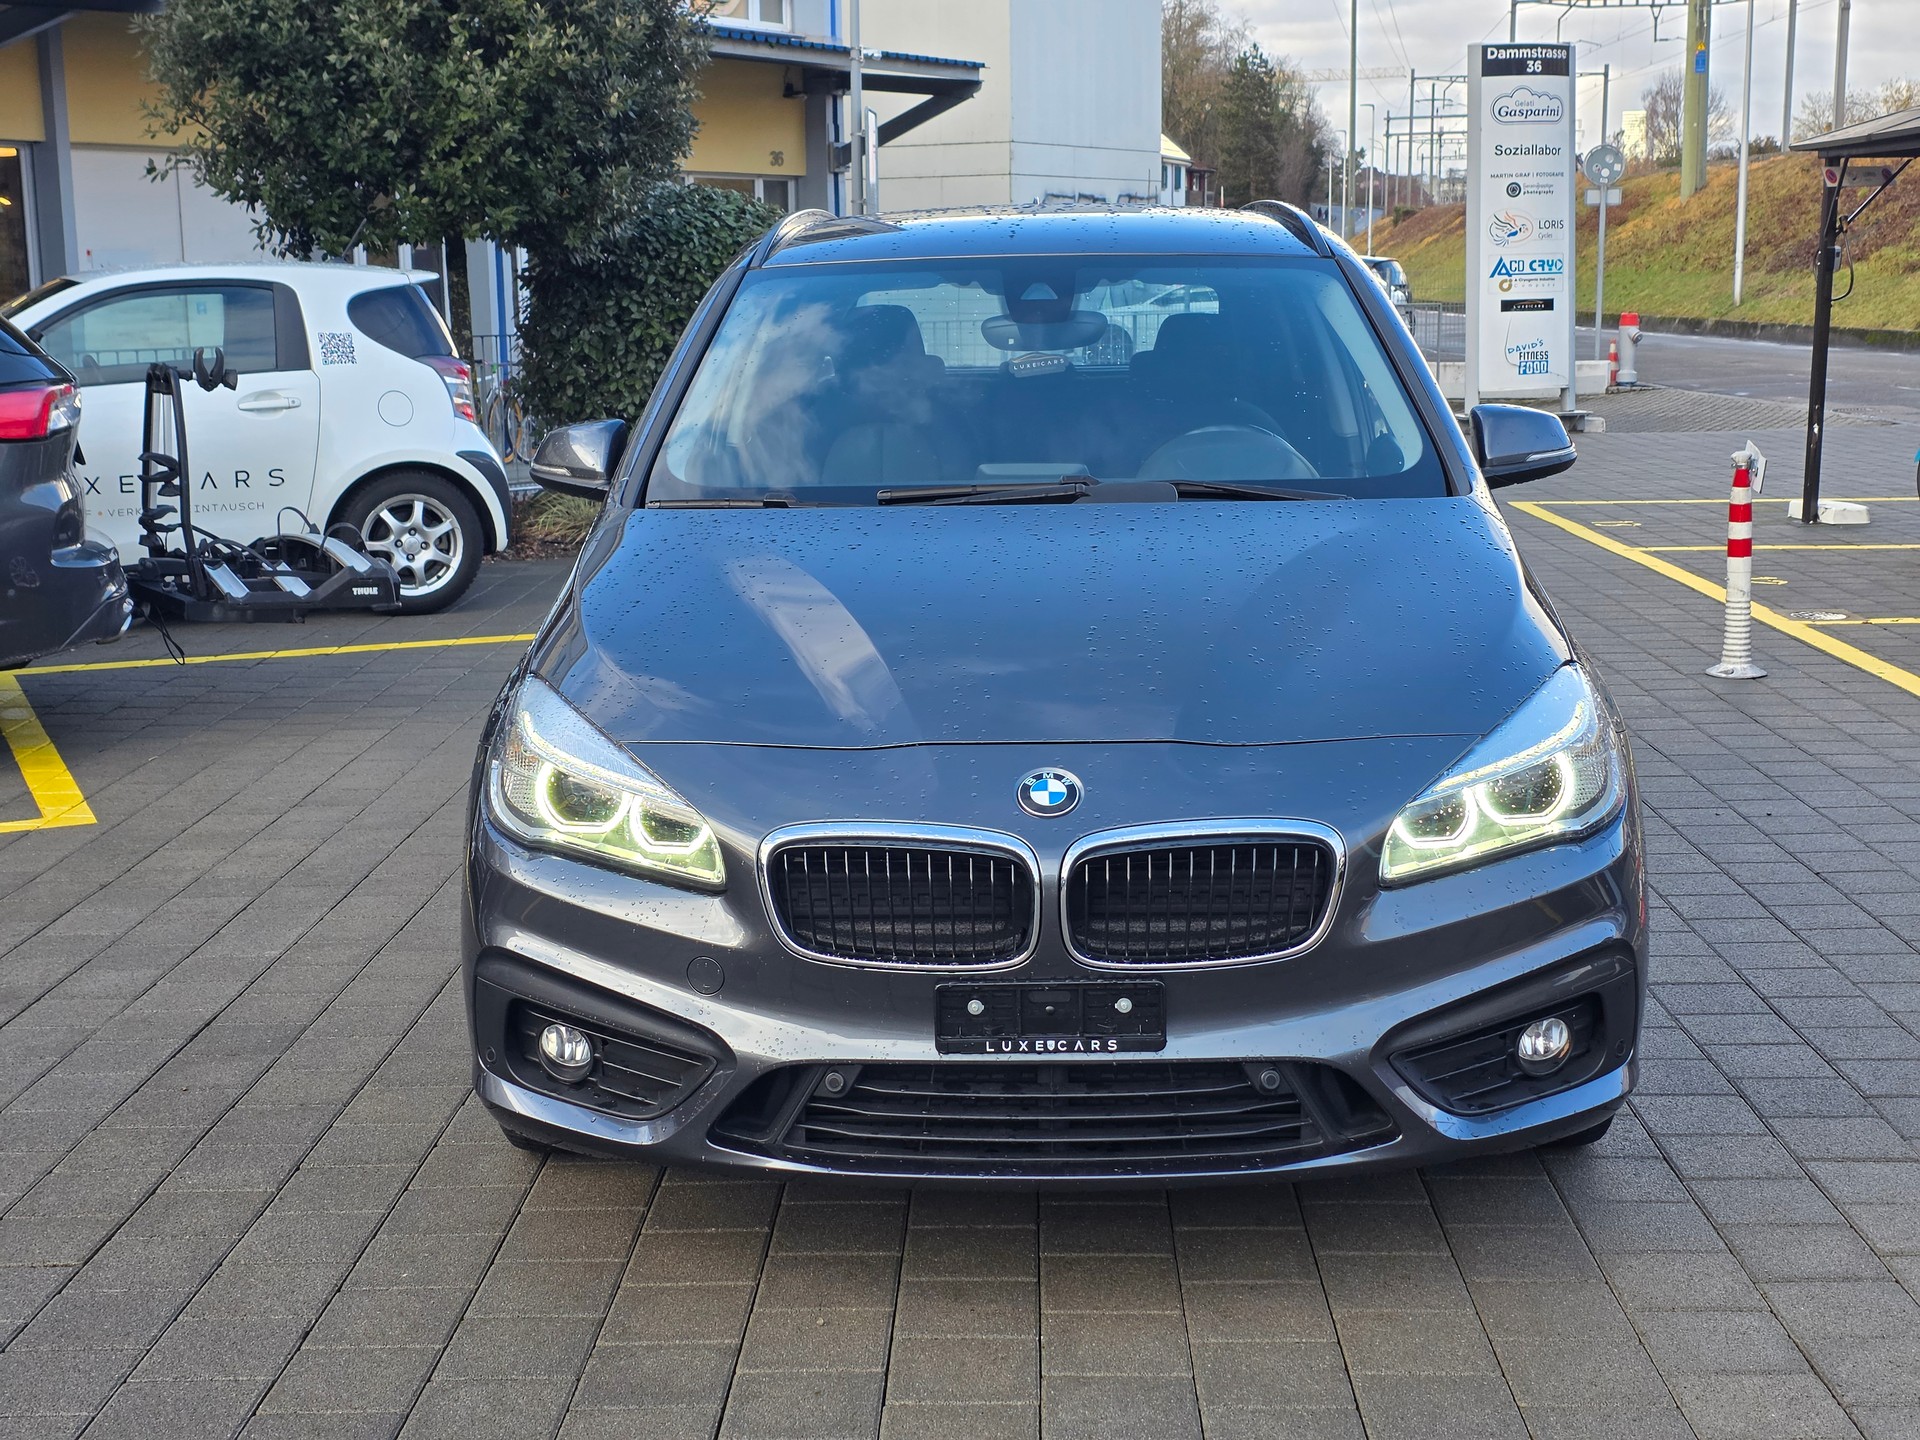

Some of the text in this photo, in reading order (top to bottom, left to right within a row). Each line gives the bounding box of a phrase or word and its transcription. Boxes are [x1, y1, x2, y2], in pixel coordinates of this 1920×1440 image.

[1487, 47, 1567, 60] Dammstrasse
[1526, 60, 1542, 72] 36
[1514, 99, 1535, 107] Gelati
[1497, 106, 1560, 119] Gasparini
[1494, 144, 1562, 156] Soziallabor
[769, 150, 785, 167] 36
[1538, 219, 1564, 230] LORIS
[1507, 337, 1544, 354] DAVID'S
[1519, 351, 1549, 361] FITNESS
[1519, 361, 1548, 375] FOOD
[107, 501, 265, 517] VERK INTAUSCH
[352, 586, 379, 596] THULE
[1024, 772, 1074, 786] BMW
